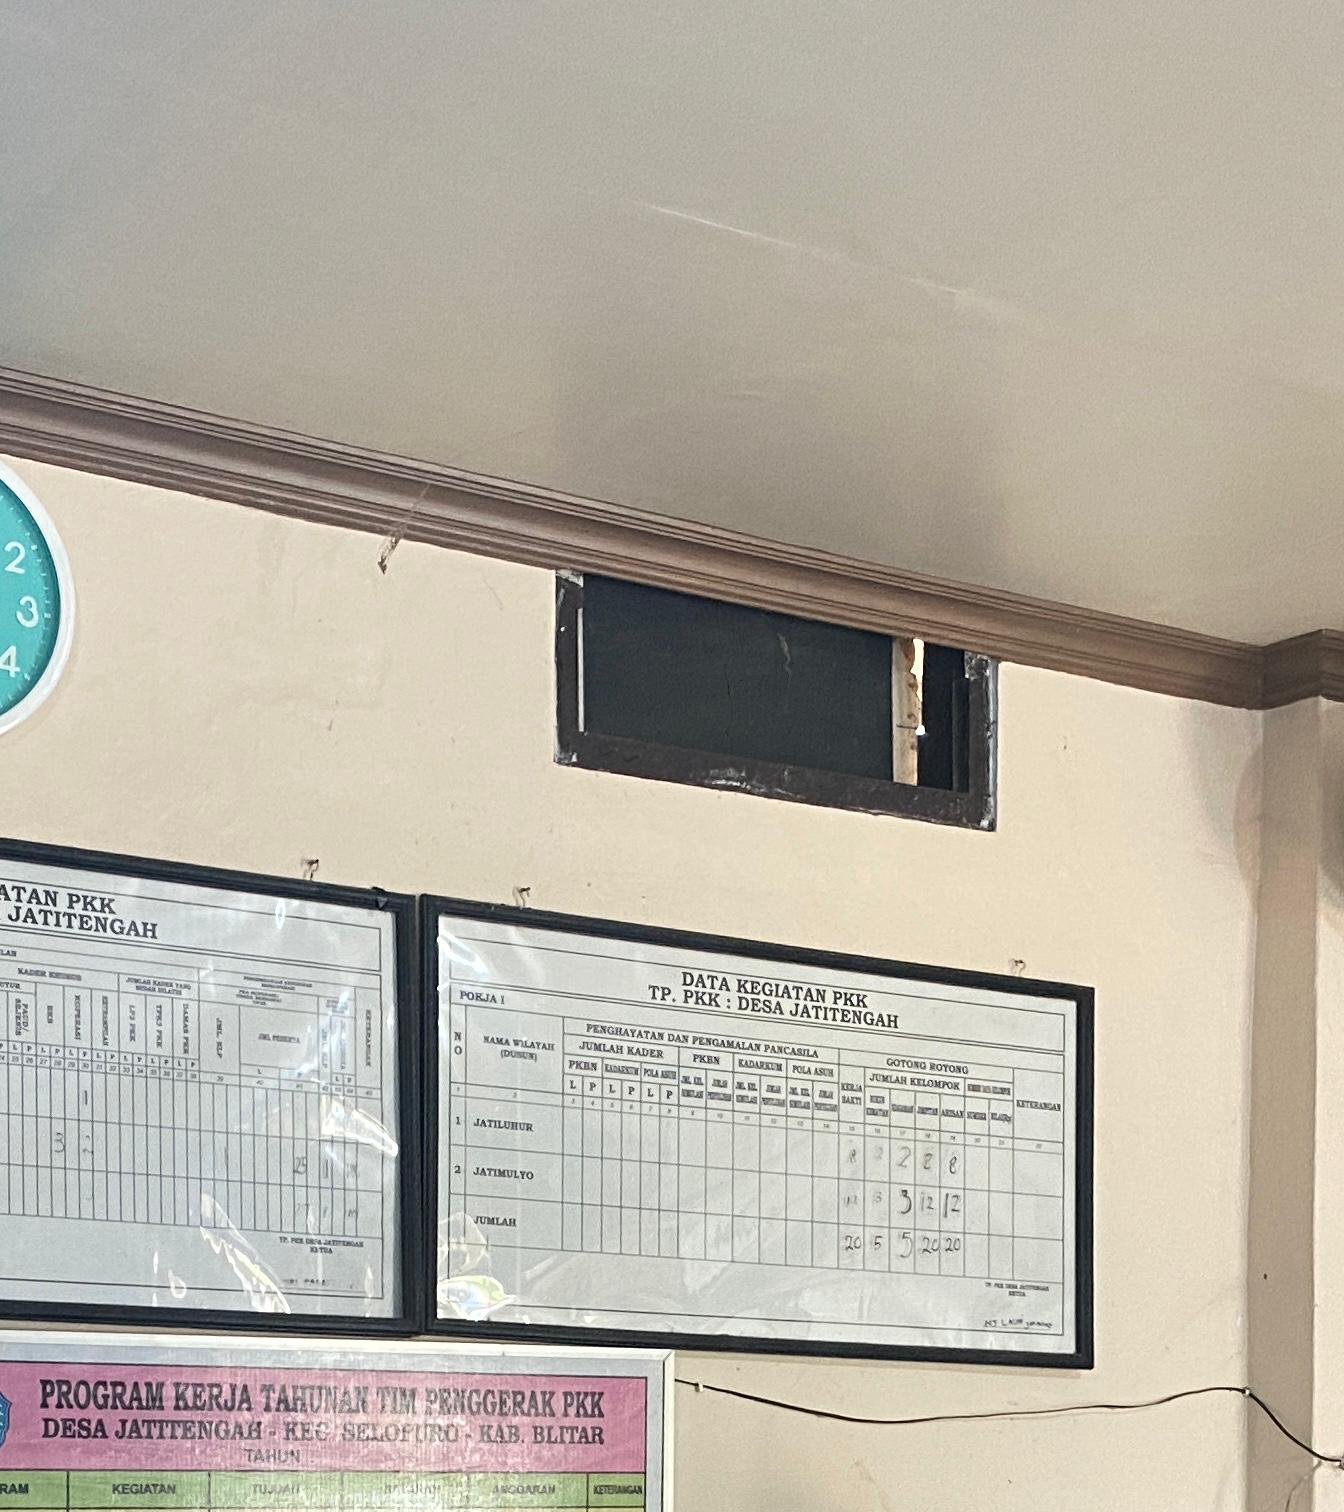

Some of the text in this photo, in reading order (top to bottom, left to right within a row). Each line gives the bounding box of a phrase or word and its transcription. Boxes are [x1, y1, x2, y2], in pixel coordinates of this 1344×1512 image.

[4, 541, 25, 575] 2
[16, 596, 39, 627] 3
[66, 893, 116, 915] PKK
[7, 906, 158, 940] JATITENGAH
[460, 990, 498, 1004] POKJA
[682, 971, 869, 1010] DATA KEGIATAN PKK
[649, 985, 899, 1029] TP. PKK DESA JATITENGAH
[483, 1035, 555, 1051] NAMA WILAYAH
[586, 1023, 819, 1058] PENGHAYATAN DAN PENGAMALAN PANCASILA
[579, 1041, 664, 1059] JUMLAH KADER
[568, 1060, 597, 1072] PKBN
[693, 1053, 720, 1065] PKBN
[886, 1058, 969, 1075] GOTONG ROYONG
[792, 1064, 834, 1078] POLA ASUH
[570, 1080, 673, 1100] L P L P L P
[869, 1073, 907, 1086] JUMLAH
[909, 1077, 960, 1091] KELOMPOK
[473, 1118, 535, 1133] JATILUHUR
[472, 1167, 534, 1180] JATIMULYO
[473, 1216, 517, 1228] JUMLAH
[873, 1235, 961, 1252] 5 20
[39, 1379, 605, 1419] PROGRAM KERJA TAHUNAN TIM PENGGERAK PKK
[41, 1418, 109, 1440] DESA
[115, 1419, 262, 1441] JATITENGAH
[478, 1425, 525, 1444] KAB.
[532, 1426, 605, 1445] BLITAR
[244, 1448, 301, 1464] TAHUN
[112, 1483, 177, 1495] KEGIATAN
[593, 1484, 643, 1496] KETERANGAN
